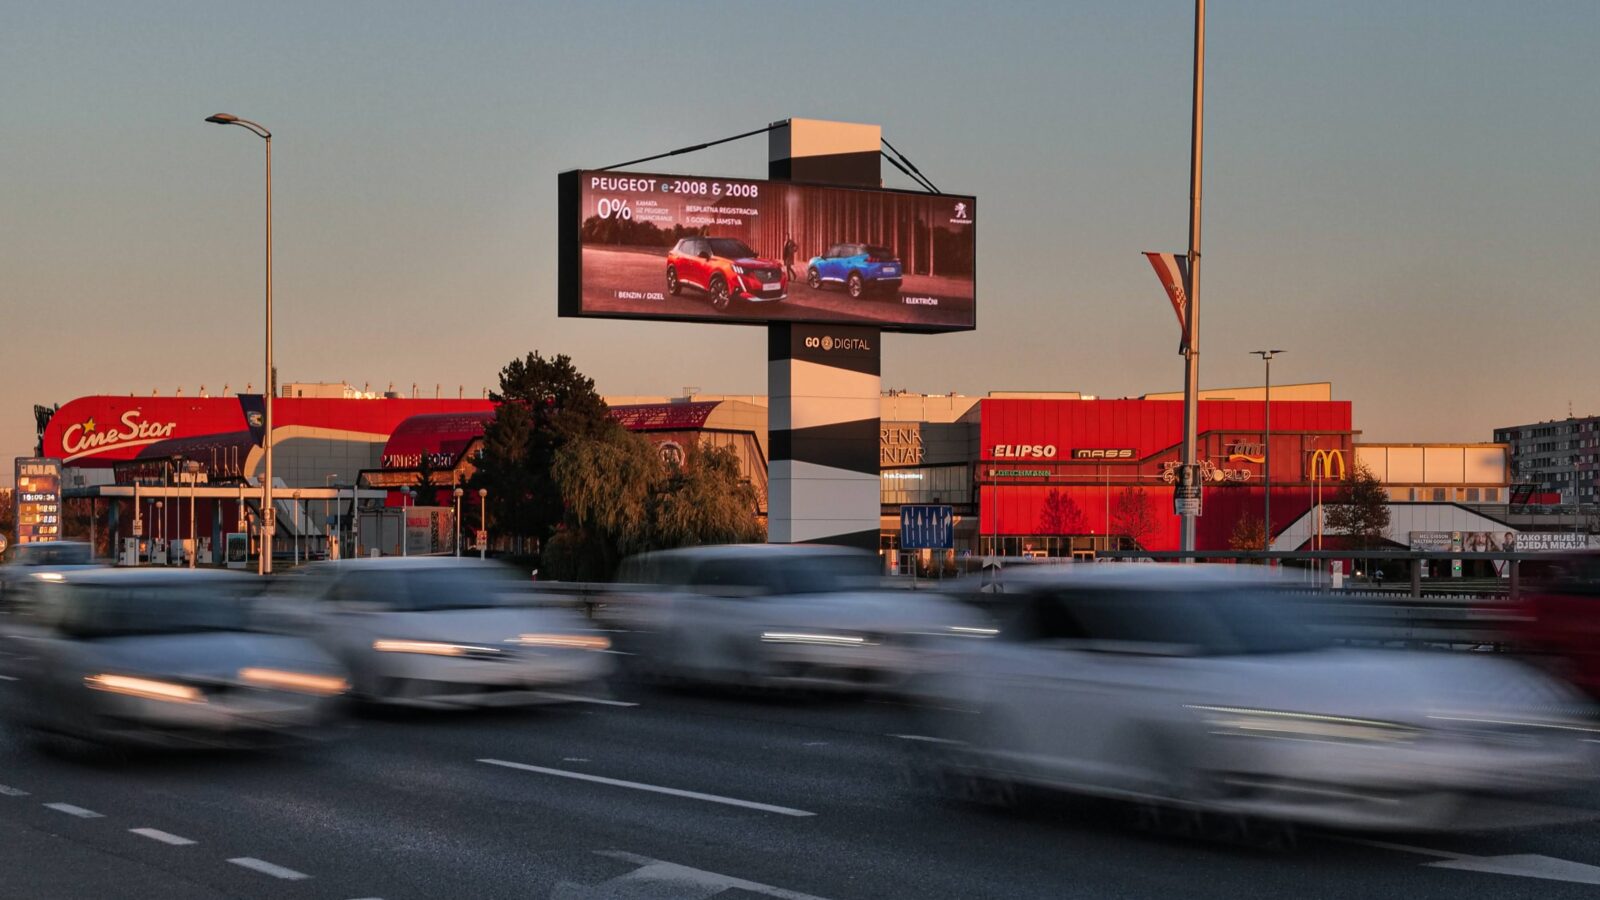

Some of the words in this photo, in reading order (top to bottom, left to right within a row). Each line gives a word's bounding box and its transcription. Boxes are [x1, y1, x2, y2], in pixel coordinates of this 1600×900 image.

[591, 177, 657, 192] PEUGEOT
[661, 180, 708, 195] e-2008
[711, 183, 722, 195] &
[725, 184, 758, 197] 2008
[597, 198, 631, 220] 0%
[686, 205, 719, 213] BESPLATNA
[719, 207, 758, 216] REGISTRACIJA
[690, 216, 715, 224] GODINA
[716, 218, 742, 226] JAMSTVA
[618, 291, 641, 299] BENZIN
[647, 292, 664, 300] DIZEL
[805, 337, 820, 348] GO
[834, 338, 870, 350] DIGITAL
[62, 410, 176, 453] CineStar
[880, 428, 923, 445] RENA
[880, 447, 925, 463] NTAR
[994, 445, 1057, 457] ELIPSO
[1077, 449, 1132, 458] MASS
[1516, 541, 1548, 550] DJEDA
